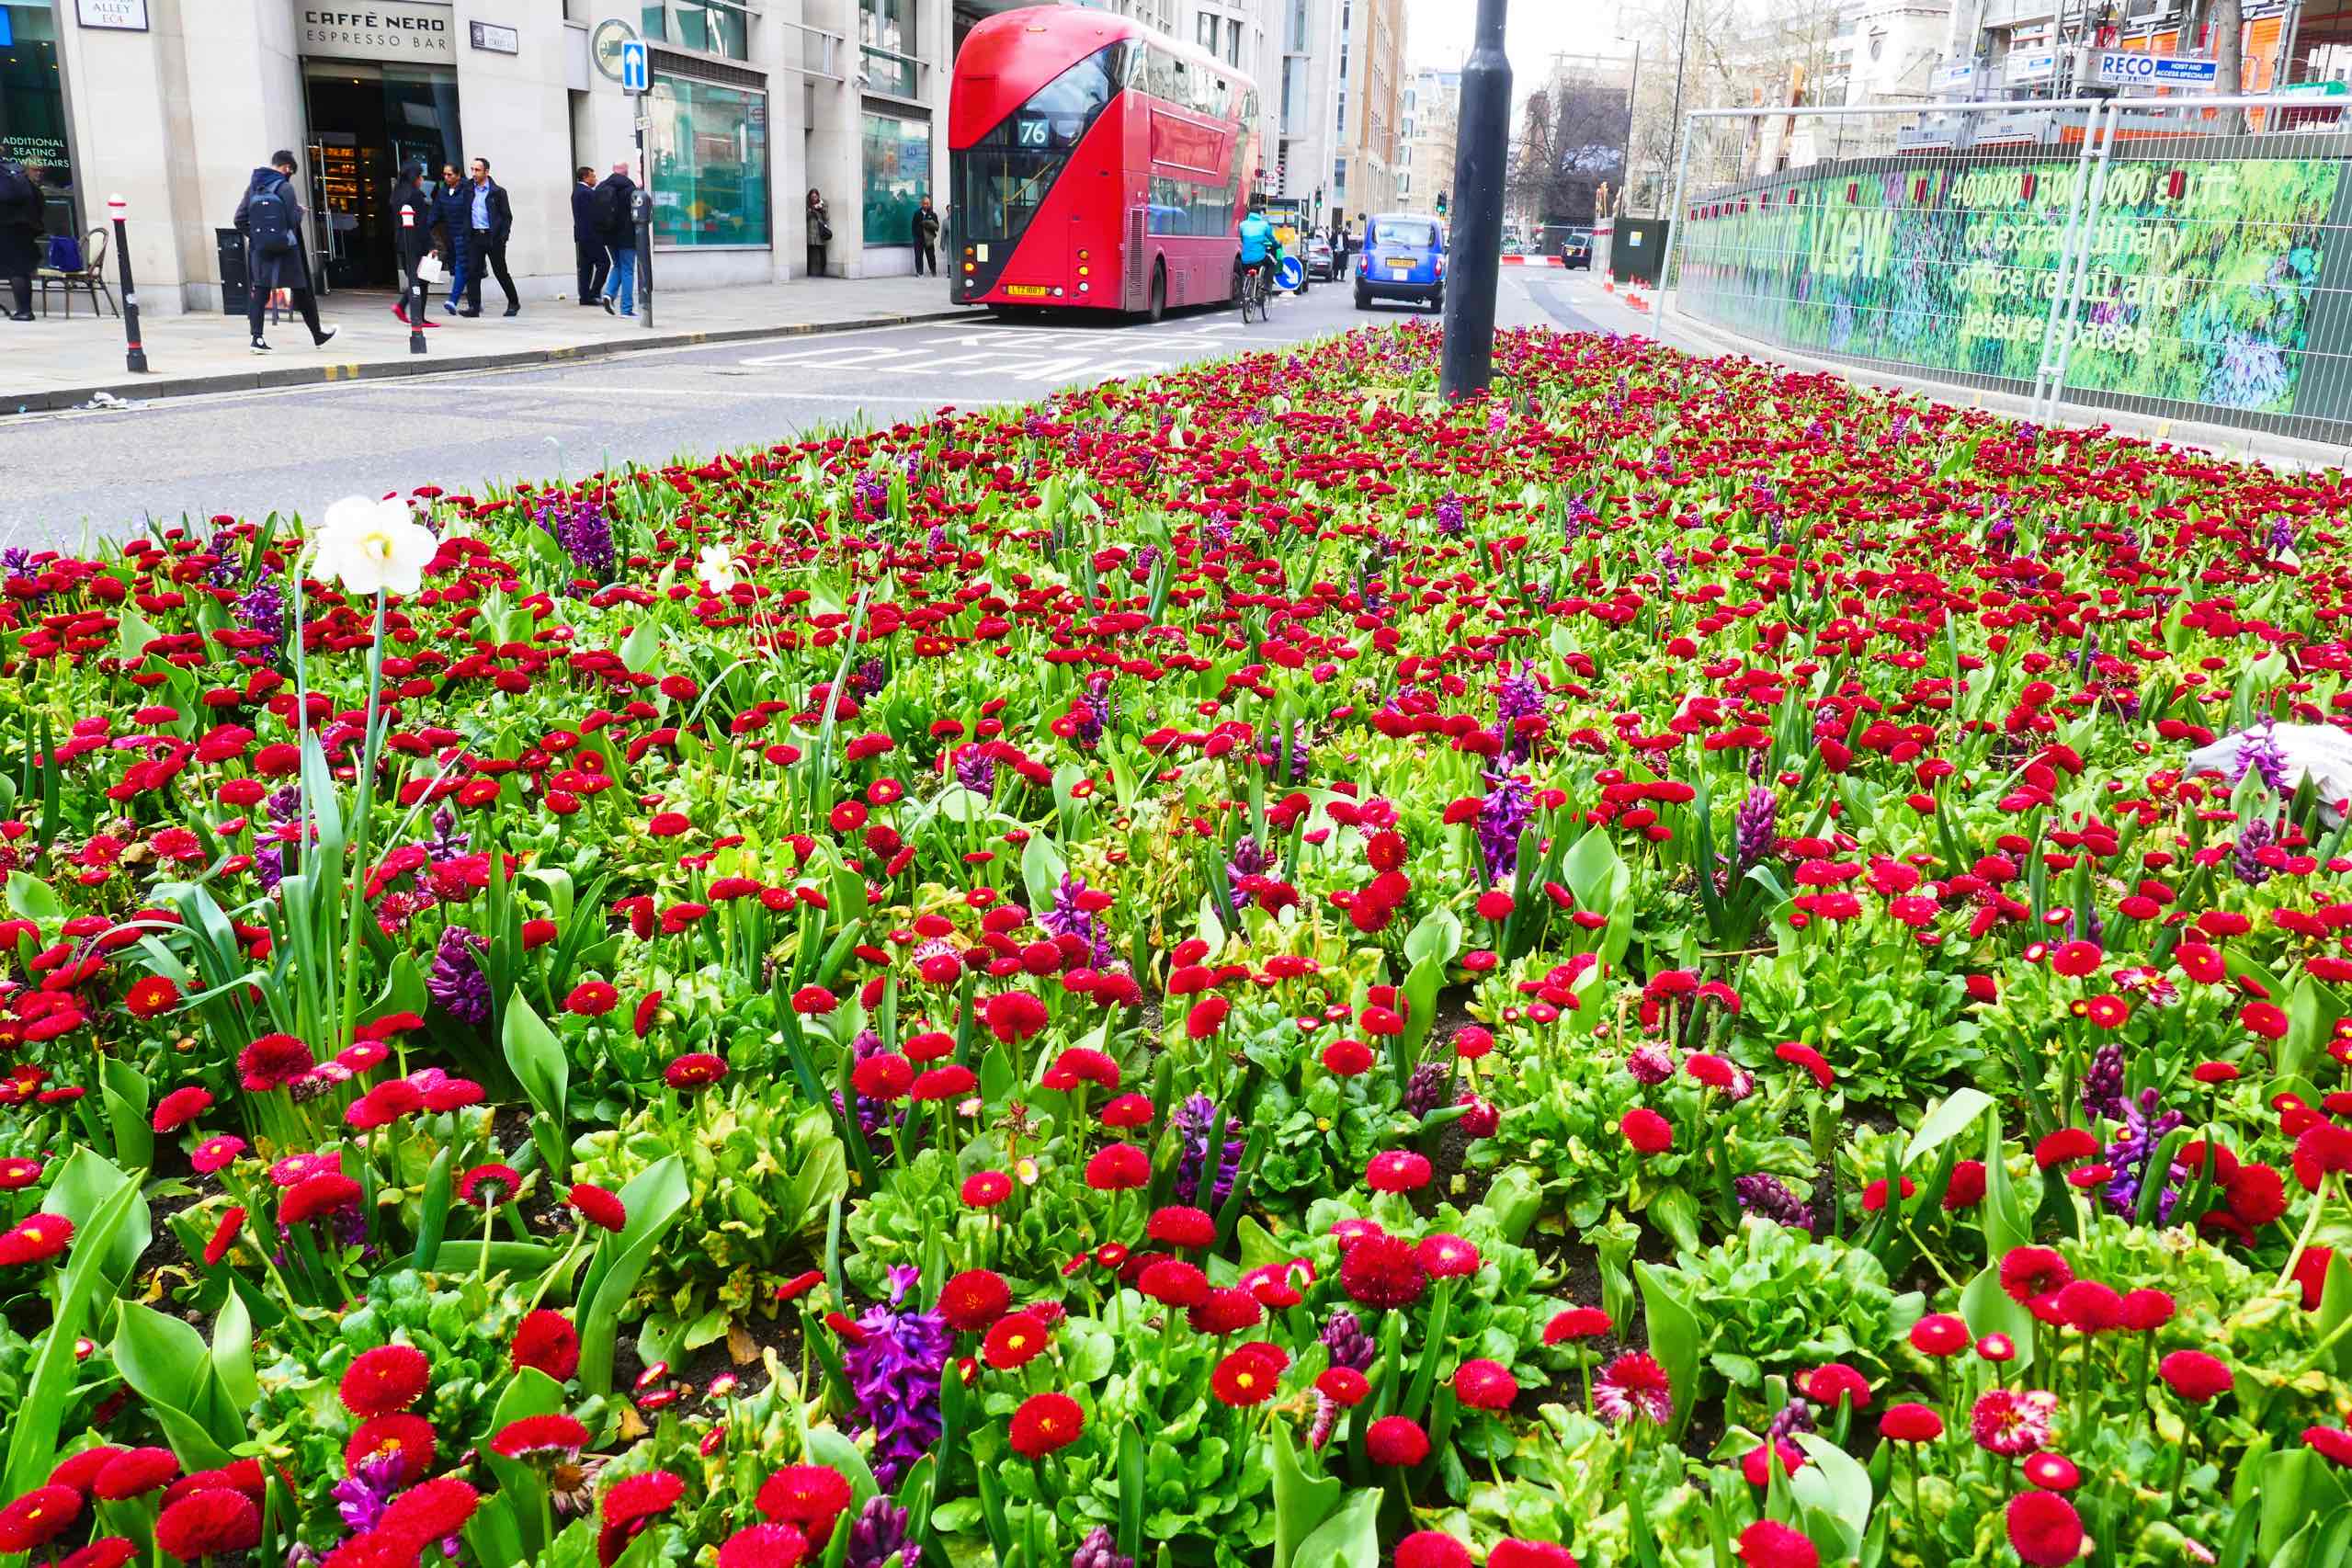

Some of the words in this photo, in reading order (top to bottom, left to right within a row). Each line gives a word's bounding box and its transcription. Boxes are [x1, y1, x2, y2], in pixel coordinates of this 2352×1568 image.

[94, 3, 131, 13] ALLEY
[305, 10, 378, 28] CAFFÈ
[386, 17, 444, 31] NERO
[307, 29, 401, 46] ESPRESSO
[413, 37, 446, 50] BAR
[2103, 56, 2153, 75] RECO
[3, 137, 64, 147] ADDITIONAL
[1021, 121, 1046, 143] 76
[14, 147, 56, 157] SEATING
[2122, 269, 2183, 307] and
[1964, 302, 2044, 343] leisure
[918, 331, 1222, 353] KEEP
[739, 346, 1174, 382] CLEAR
